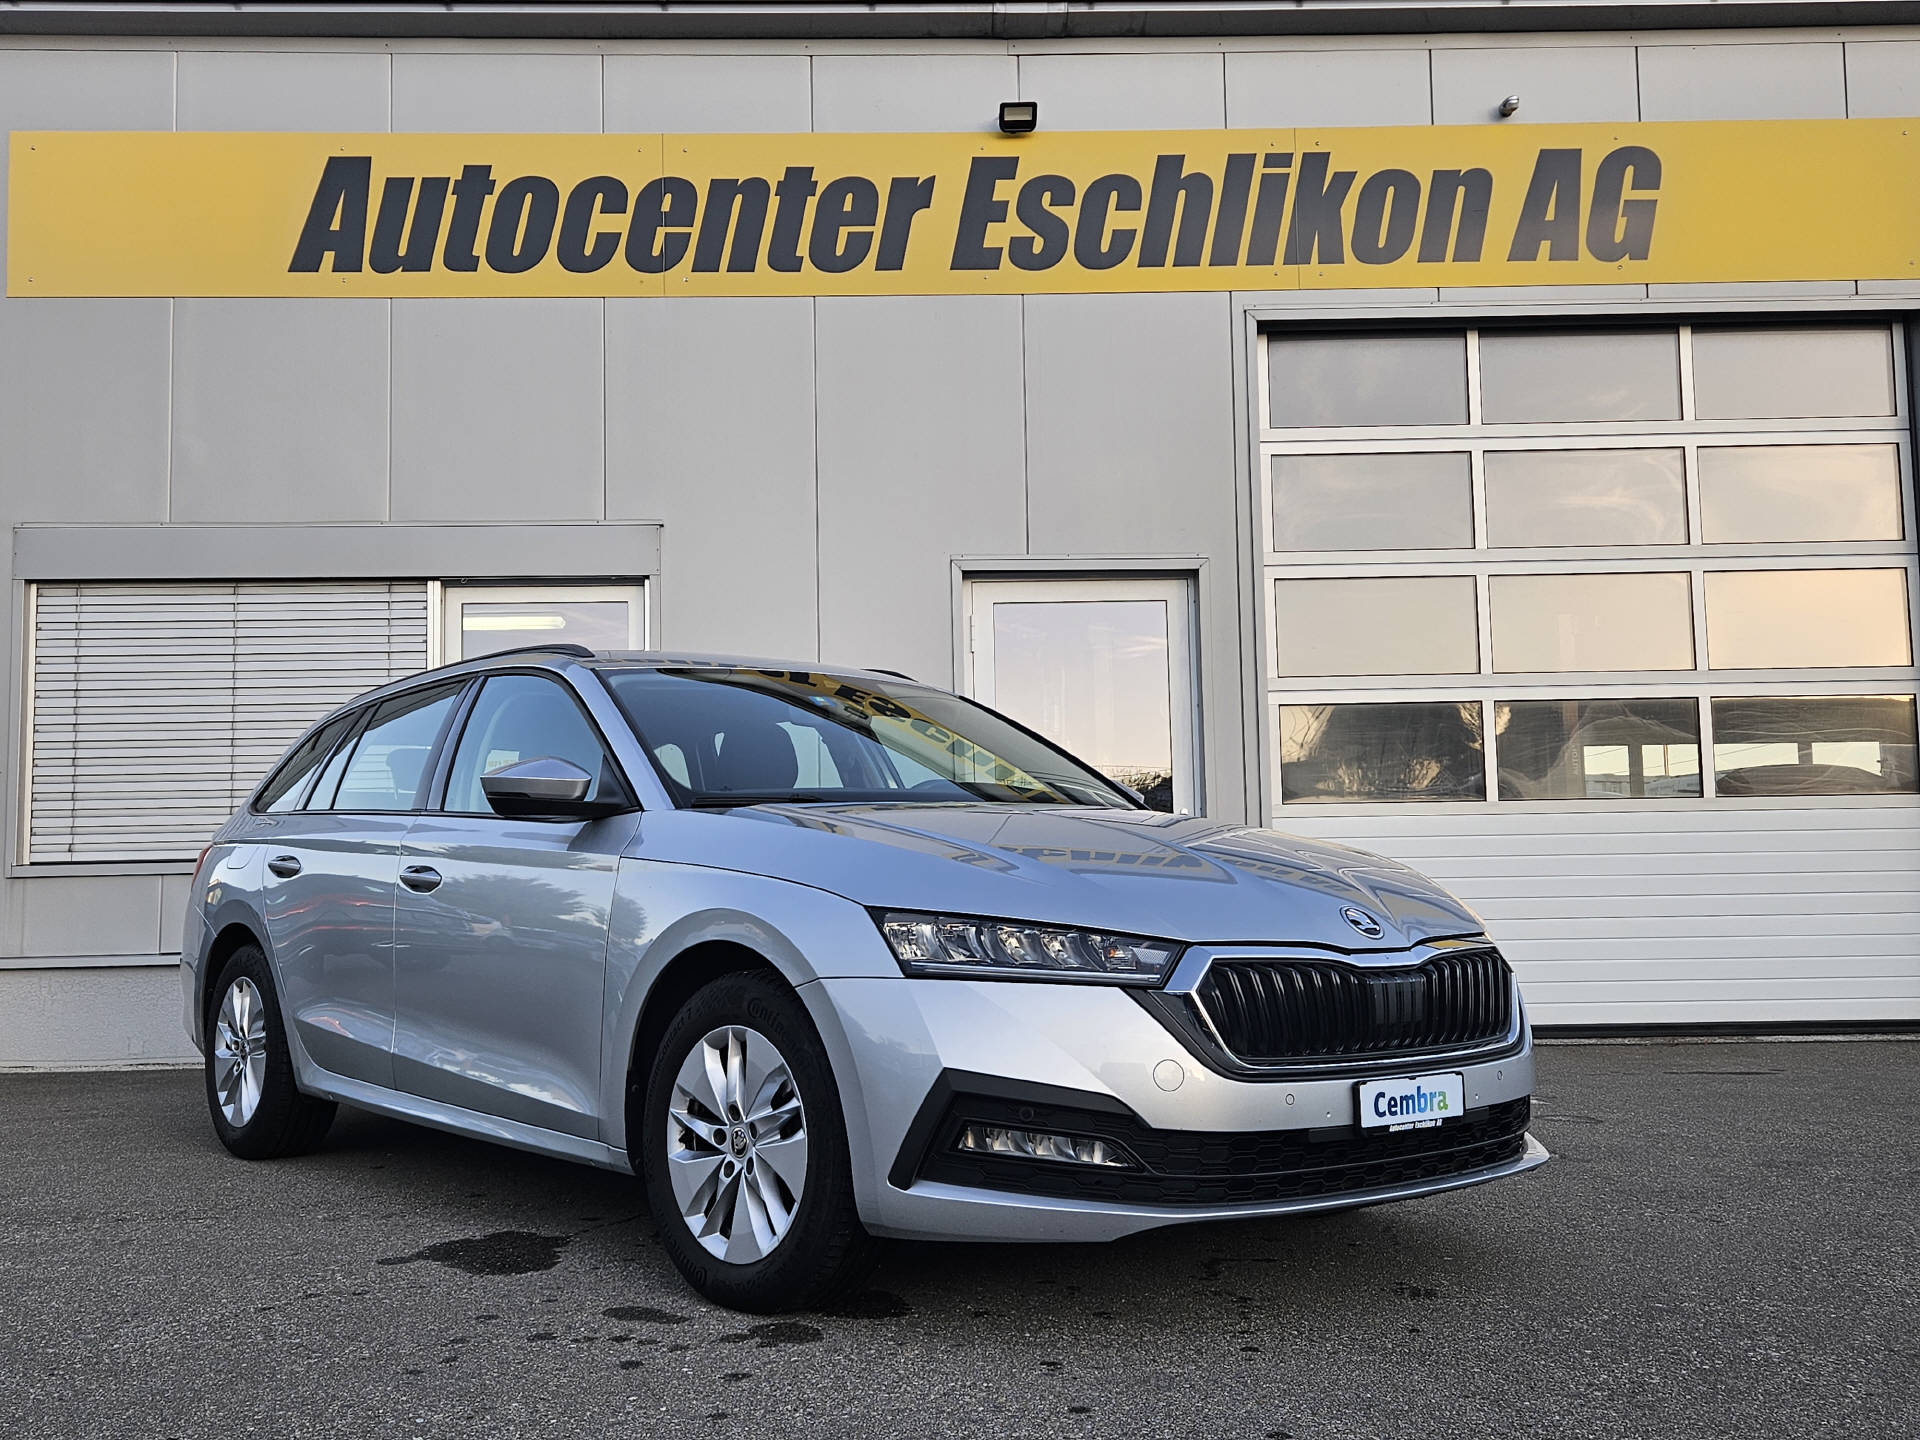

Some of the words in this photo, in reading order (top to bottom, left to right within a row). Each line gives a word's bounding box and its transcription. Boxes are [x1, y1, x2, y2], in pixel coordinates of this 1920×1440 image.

[288, 156, 936, 275] Autocenter
[950, 151, 1494, 272] Eschlikon
[1507, 146, 1662, 263] AG
[1374, 1086, 1448, 1118] Cembra
